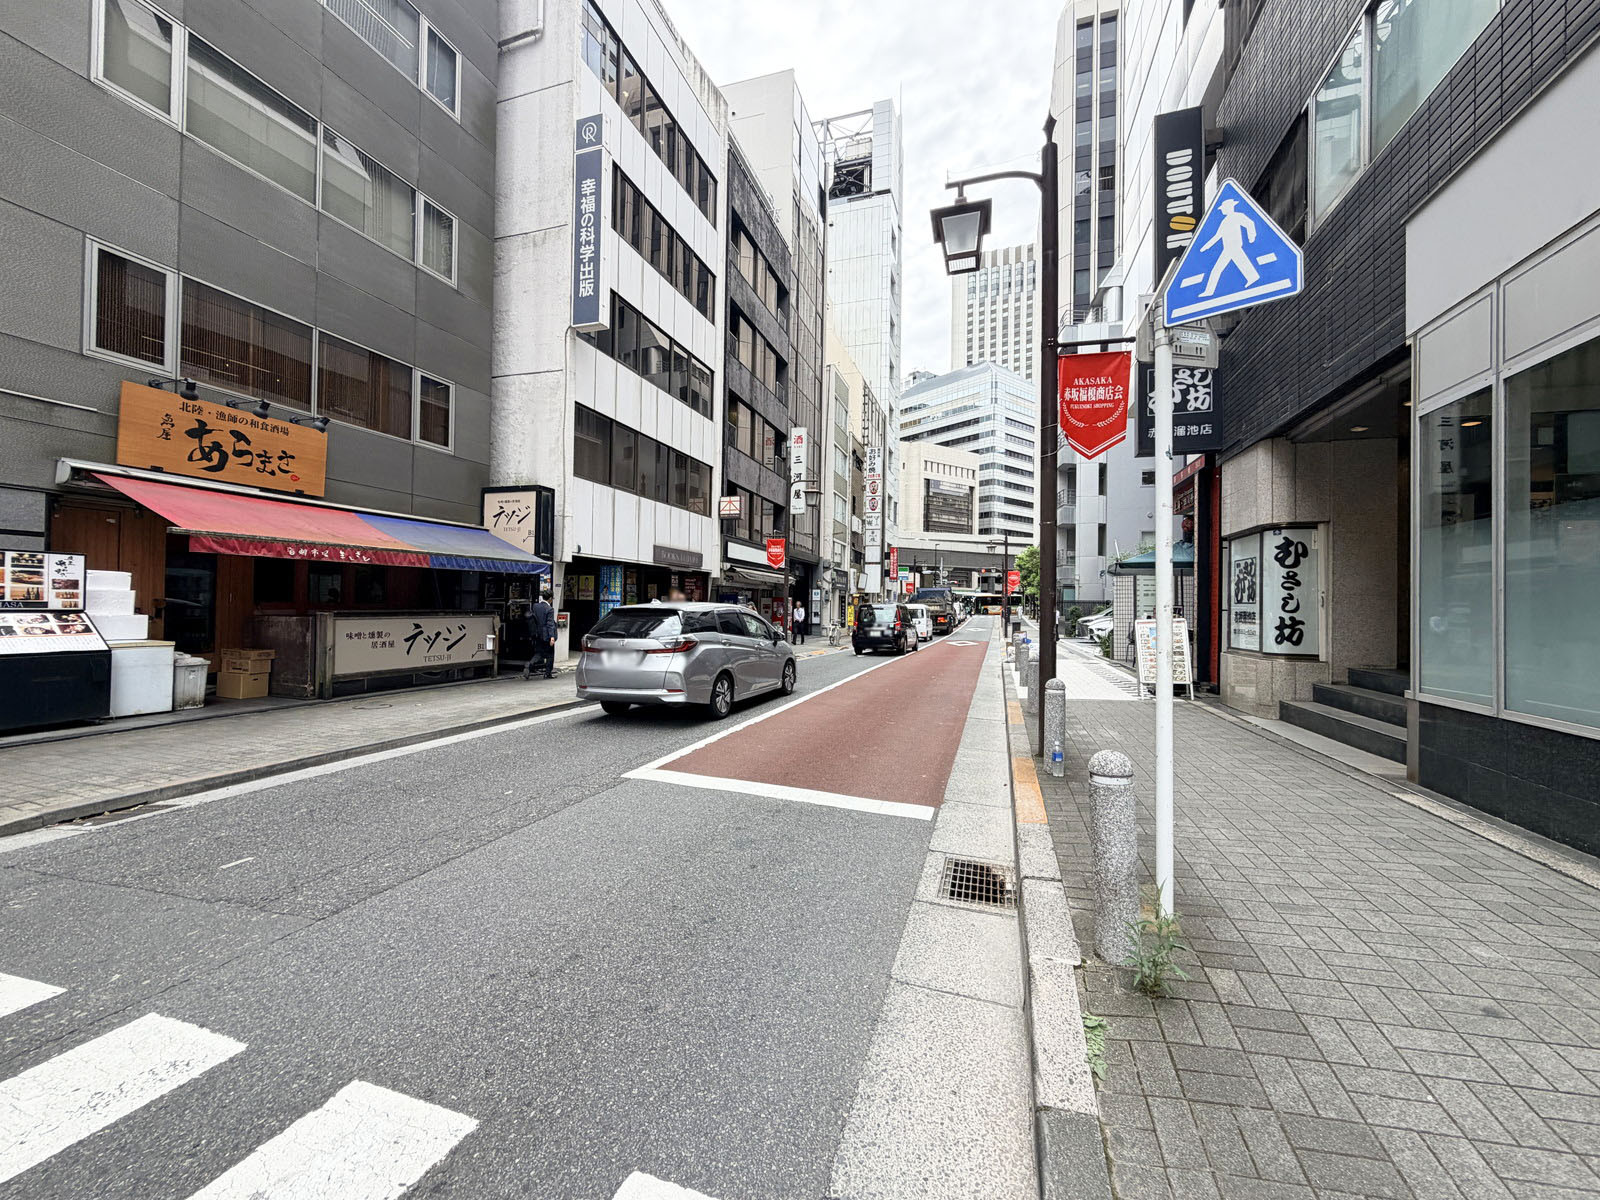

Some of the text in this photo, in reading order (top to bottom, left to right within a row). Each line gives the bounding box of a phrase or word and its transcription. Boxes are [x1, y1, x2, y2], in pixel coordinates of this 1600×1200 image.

[1166, 148, 1197, 249] DOUTOR
[579, 178, 596, 298] 幸福の科学出版
[1064, 385, 1124, 402] 赤坂福榎商店会
[1073, 376, 1113, 386] AKASAKA
[156, 413, 175, 441] 魚屋
[179, 401, 290, 437] 北陸・漁師の和食酒場
[1148, 424, 1213, 438] 赤溜池店
[184, 418, 296, 477] あらまさ
[793, 434, 804, 444] 酒
[868, 448, 876, 473] お好み焼
[792, 455, 803, 500] 三河屋
[1274, 536, 1308, 647] むさし坊
[345, 630, 391, 640] 味噌と燻製の
[370, 640, 395, 649] 居酒屋
[423, 653, 452, 663] TETSU-JI
